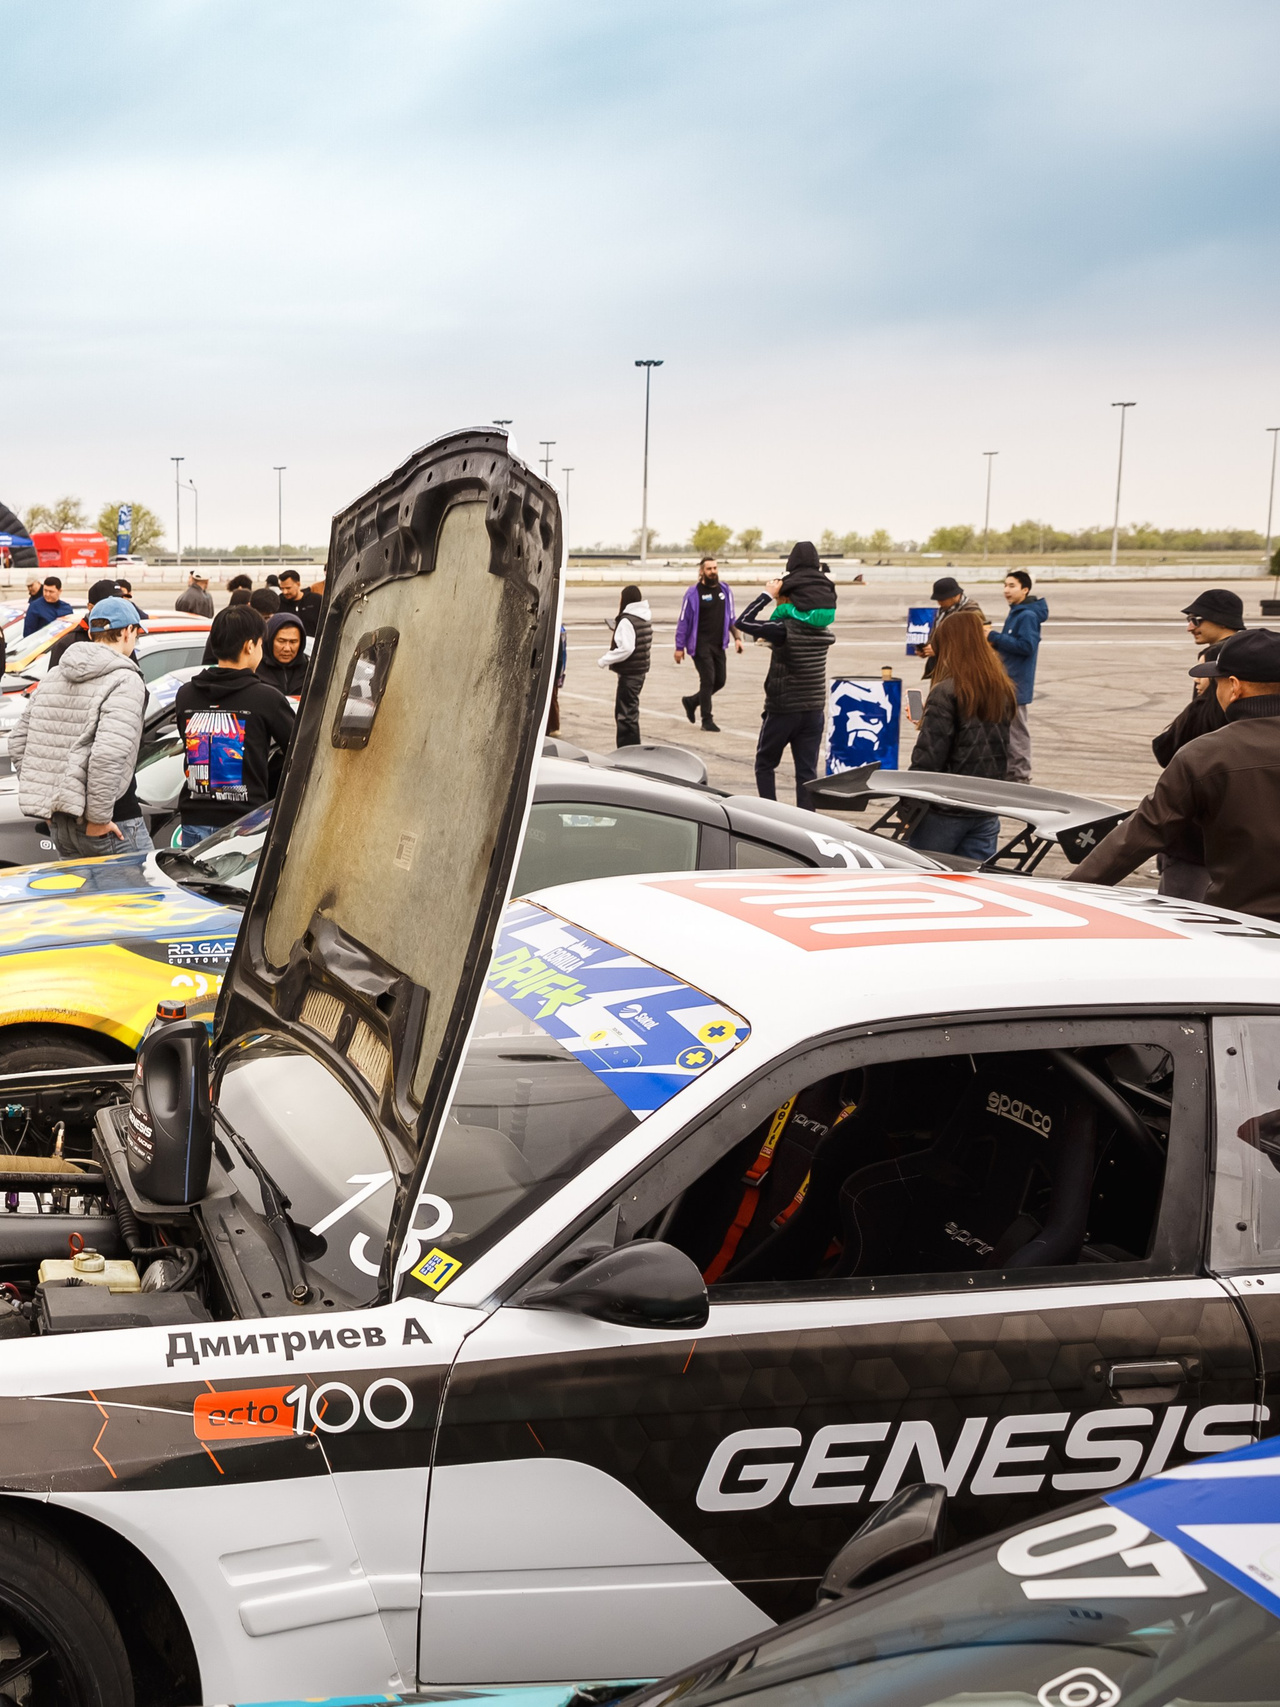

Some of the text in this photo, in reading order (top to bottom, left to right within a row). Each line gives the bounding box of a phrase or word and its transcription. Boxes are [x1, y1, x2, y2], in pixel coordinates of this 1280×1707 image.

[168, 943, 194, 955] RR
[543, 946, 585, 974] GORILLA
[488, 946, 587, 1020] DRIFT
[986, 1091, 1052, 1134] sparco
[165, 1317, 433, 1368] Дмитриев А
[695, 1403, 1271, 1512] GENESIS
